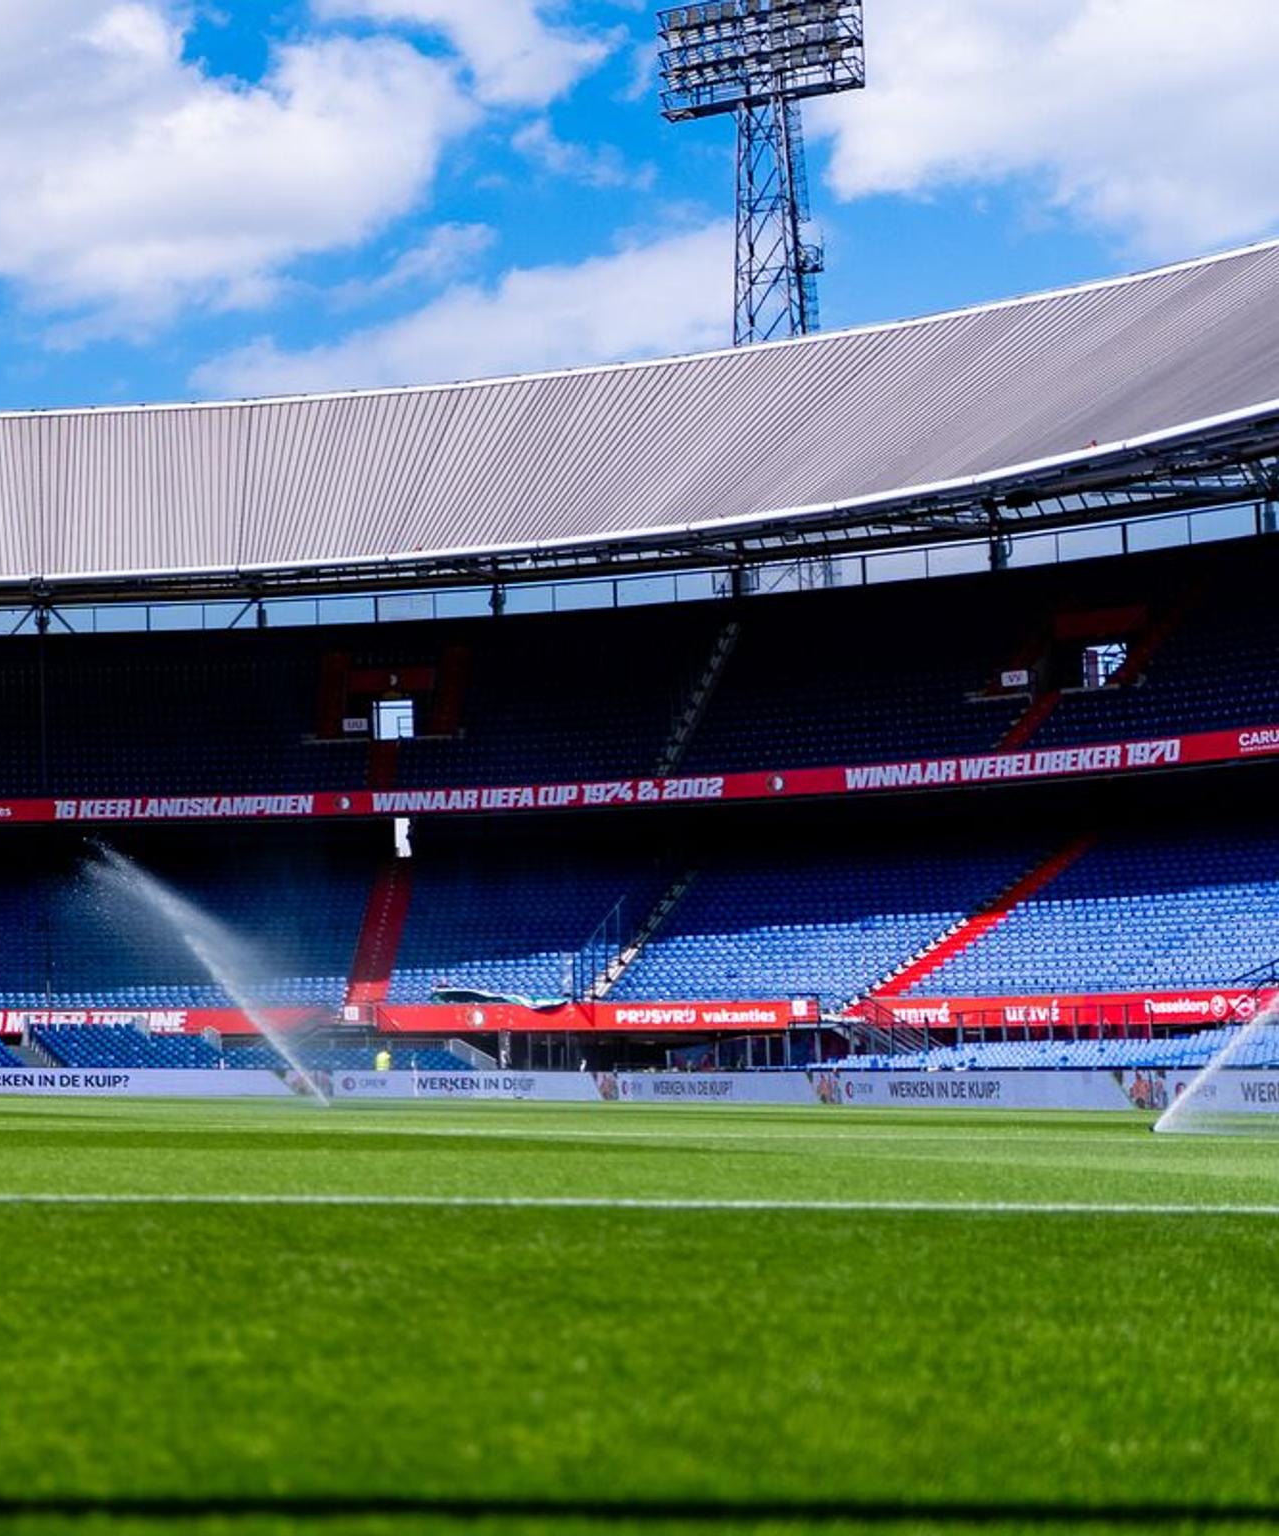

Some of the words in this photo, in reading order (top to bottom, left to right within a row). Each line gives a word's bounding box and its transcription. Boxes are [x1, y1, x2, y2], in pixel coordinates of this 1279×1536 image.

[845, 760, 957, 790] WINNAAR
[959, 745, 1122, 779] WERELDBEKER
[1125, 740, 1181, 766] 1970
[372, 789, 480, 812] WINNAAR
[480, 786, 535, 809] UEFA
[538, 785, 577, 807] CUP
[582, 781, 633, 804] 1974
[663, 776, 724, 800] 2002
[53, 800, 77, 820] 16
[78, 798, 131, 819] KEER
[132, 795, 315, 819] LANDSKAMPIOEN
[702, 1008, 777, 1024] vakanties
[39, 1074, 55, 1088] IN
[60, 1074, 80, 1088] DE
[84, 1074, 129, 1088] KUIP?
[484, 1077, 499, 1090] IN
[888, 1082, 935, 1098] WERKEN
[937, 1082, 949, 1098] IN
[951, 1082, 966, 1098] DE
[1241, 1082, 1279, 1103] WER
